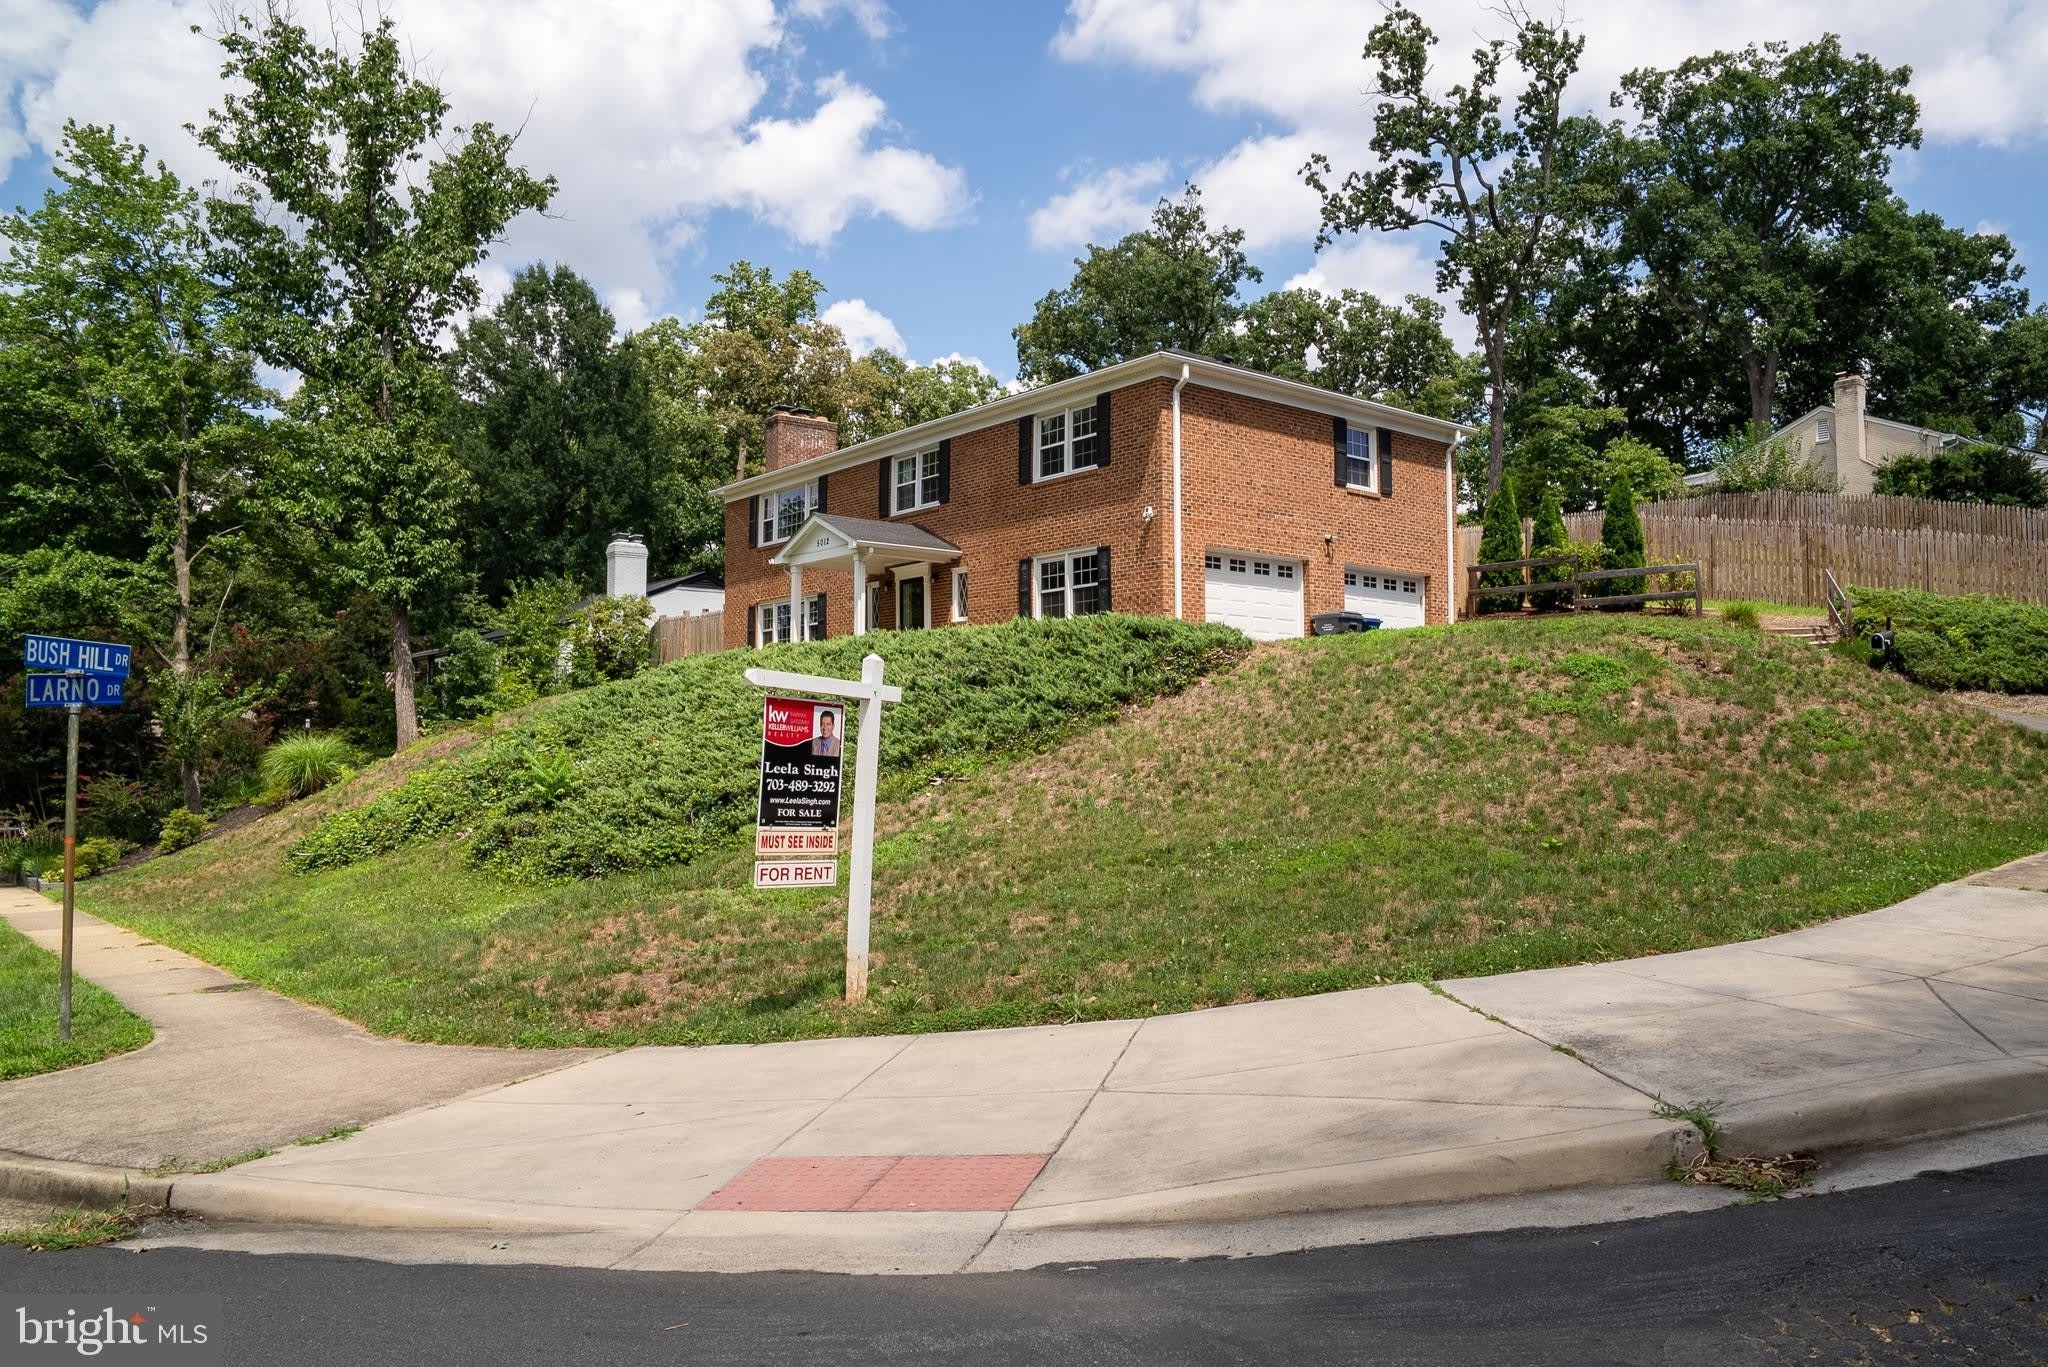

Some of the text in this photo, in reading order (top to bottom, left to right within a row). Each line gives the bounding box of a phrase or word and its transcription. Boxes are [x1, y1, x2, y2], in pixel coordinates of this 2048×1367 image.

[26, 639, 129, 672] BUSH HILL DR
[29, 678, 121, 702] LARNO DR
[768, 704, 789, 723] kw
[764, 761, 839, 779] Leela Singh
[766, 778, 836, 793] 703-489-3292
[769, 796, 831, 806] www.LeelaSingh.com
[777, 808, 822, 818] FOR SALE
[760, 835, 834, 849] MUST SEE INSIDE
[759, 866, 833, 882] FOR RENT
